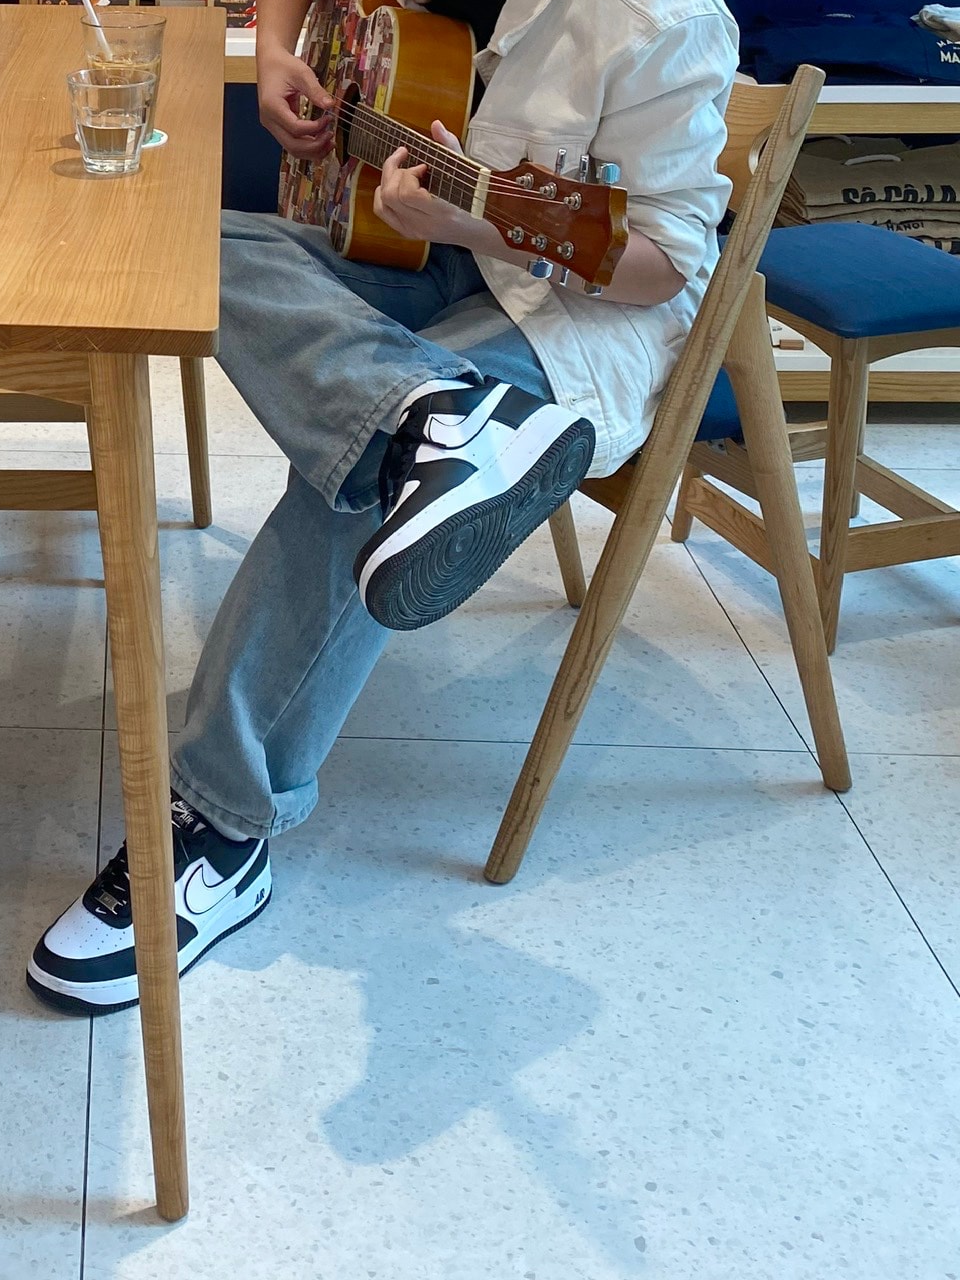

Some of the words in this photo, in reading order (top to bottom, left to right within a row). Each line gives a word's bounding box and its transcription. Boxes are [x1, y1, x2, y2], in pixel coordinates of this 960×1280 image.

[886, 222, 925, 231] HANOI
[180, 812, 194, 825] AIR
[255, 888, 265, 907] AIR
